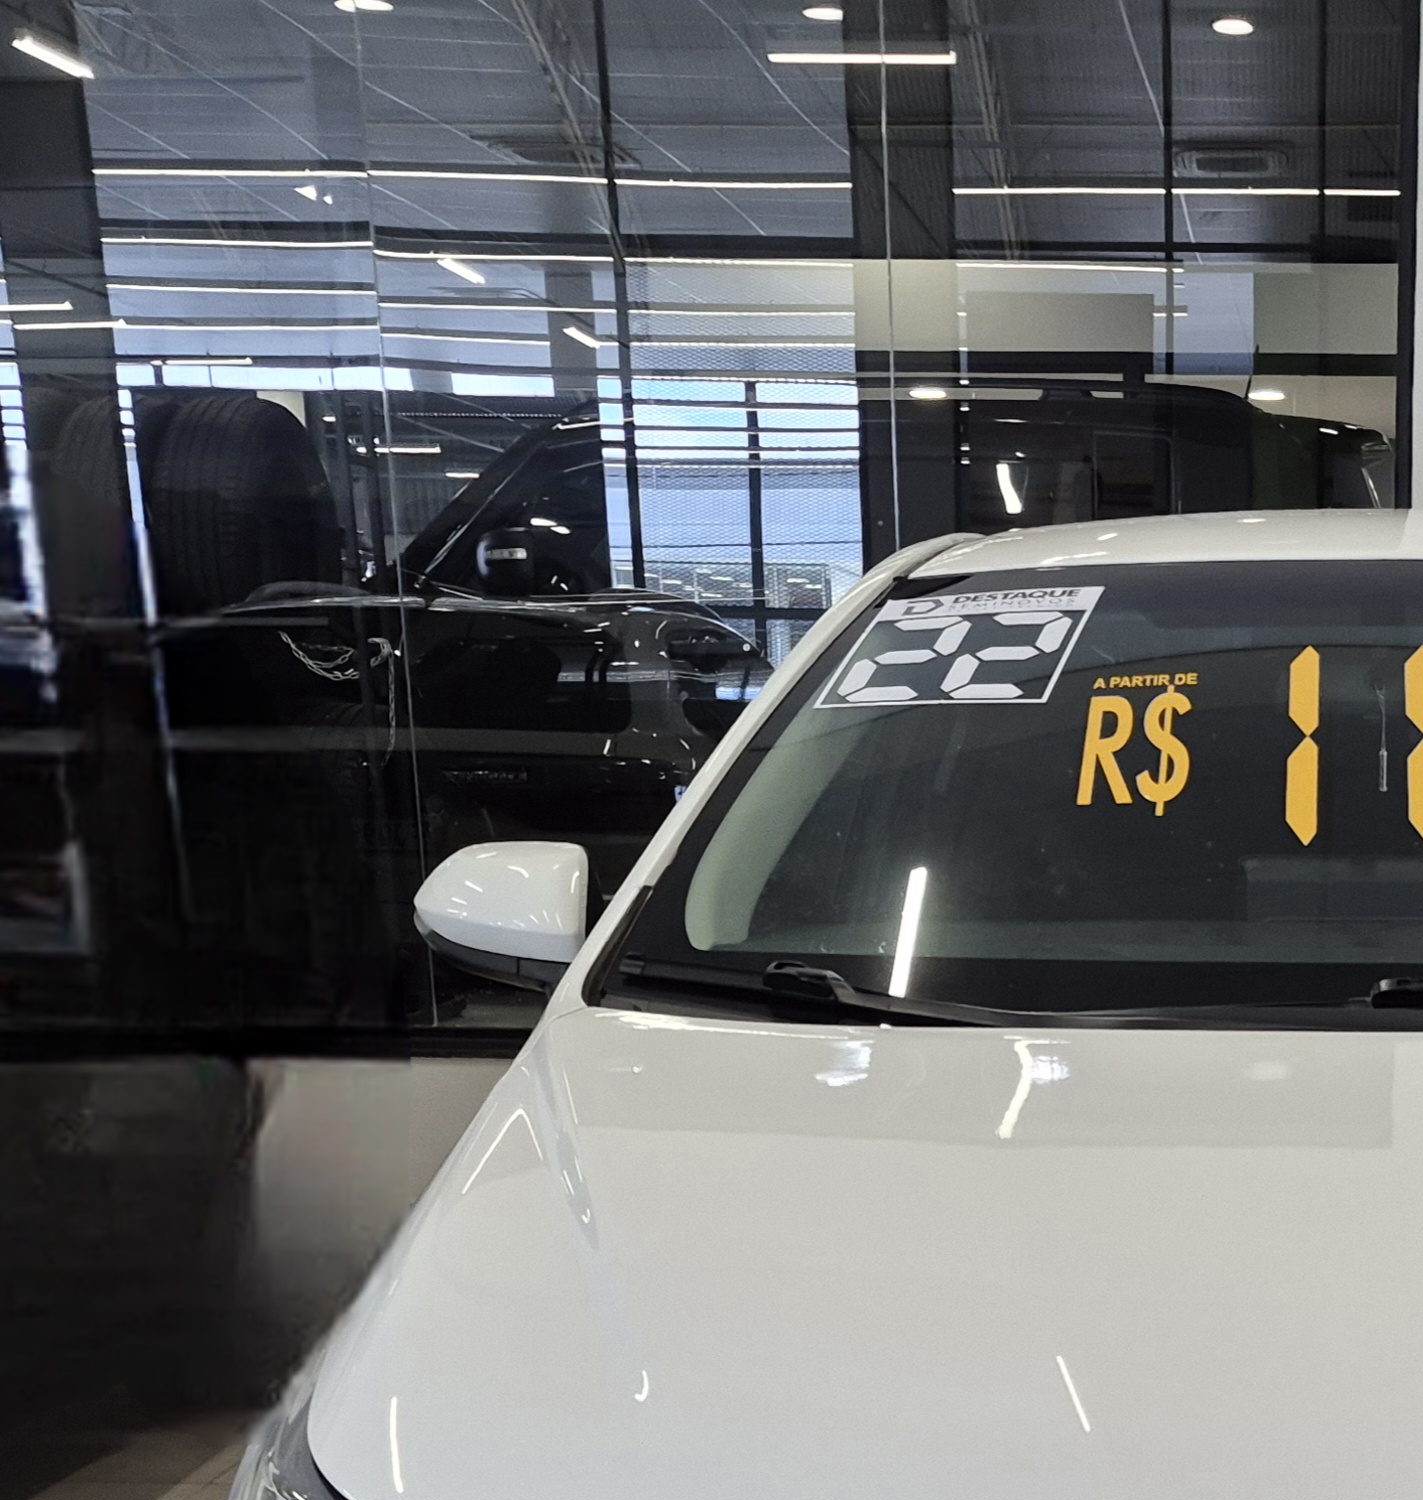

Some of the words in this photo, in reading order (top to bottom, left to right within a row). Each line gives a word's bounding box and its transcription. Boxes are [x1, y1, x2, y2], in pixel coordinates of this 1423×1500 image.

[953, 588, 1082, 604] DESTAQUE
[948, 597, 1077, 612] SEMINOVOS
[837, 612, 1073, 702] 22
[1093, 678, 1107, 689] A
[1110, 674, 1171, 688] PARTIR
[1174, 673, 1198, 686] DE
[1076, 685, 1193, 816] R$
